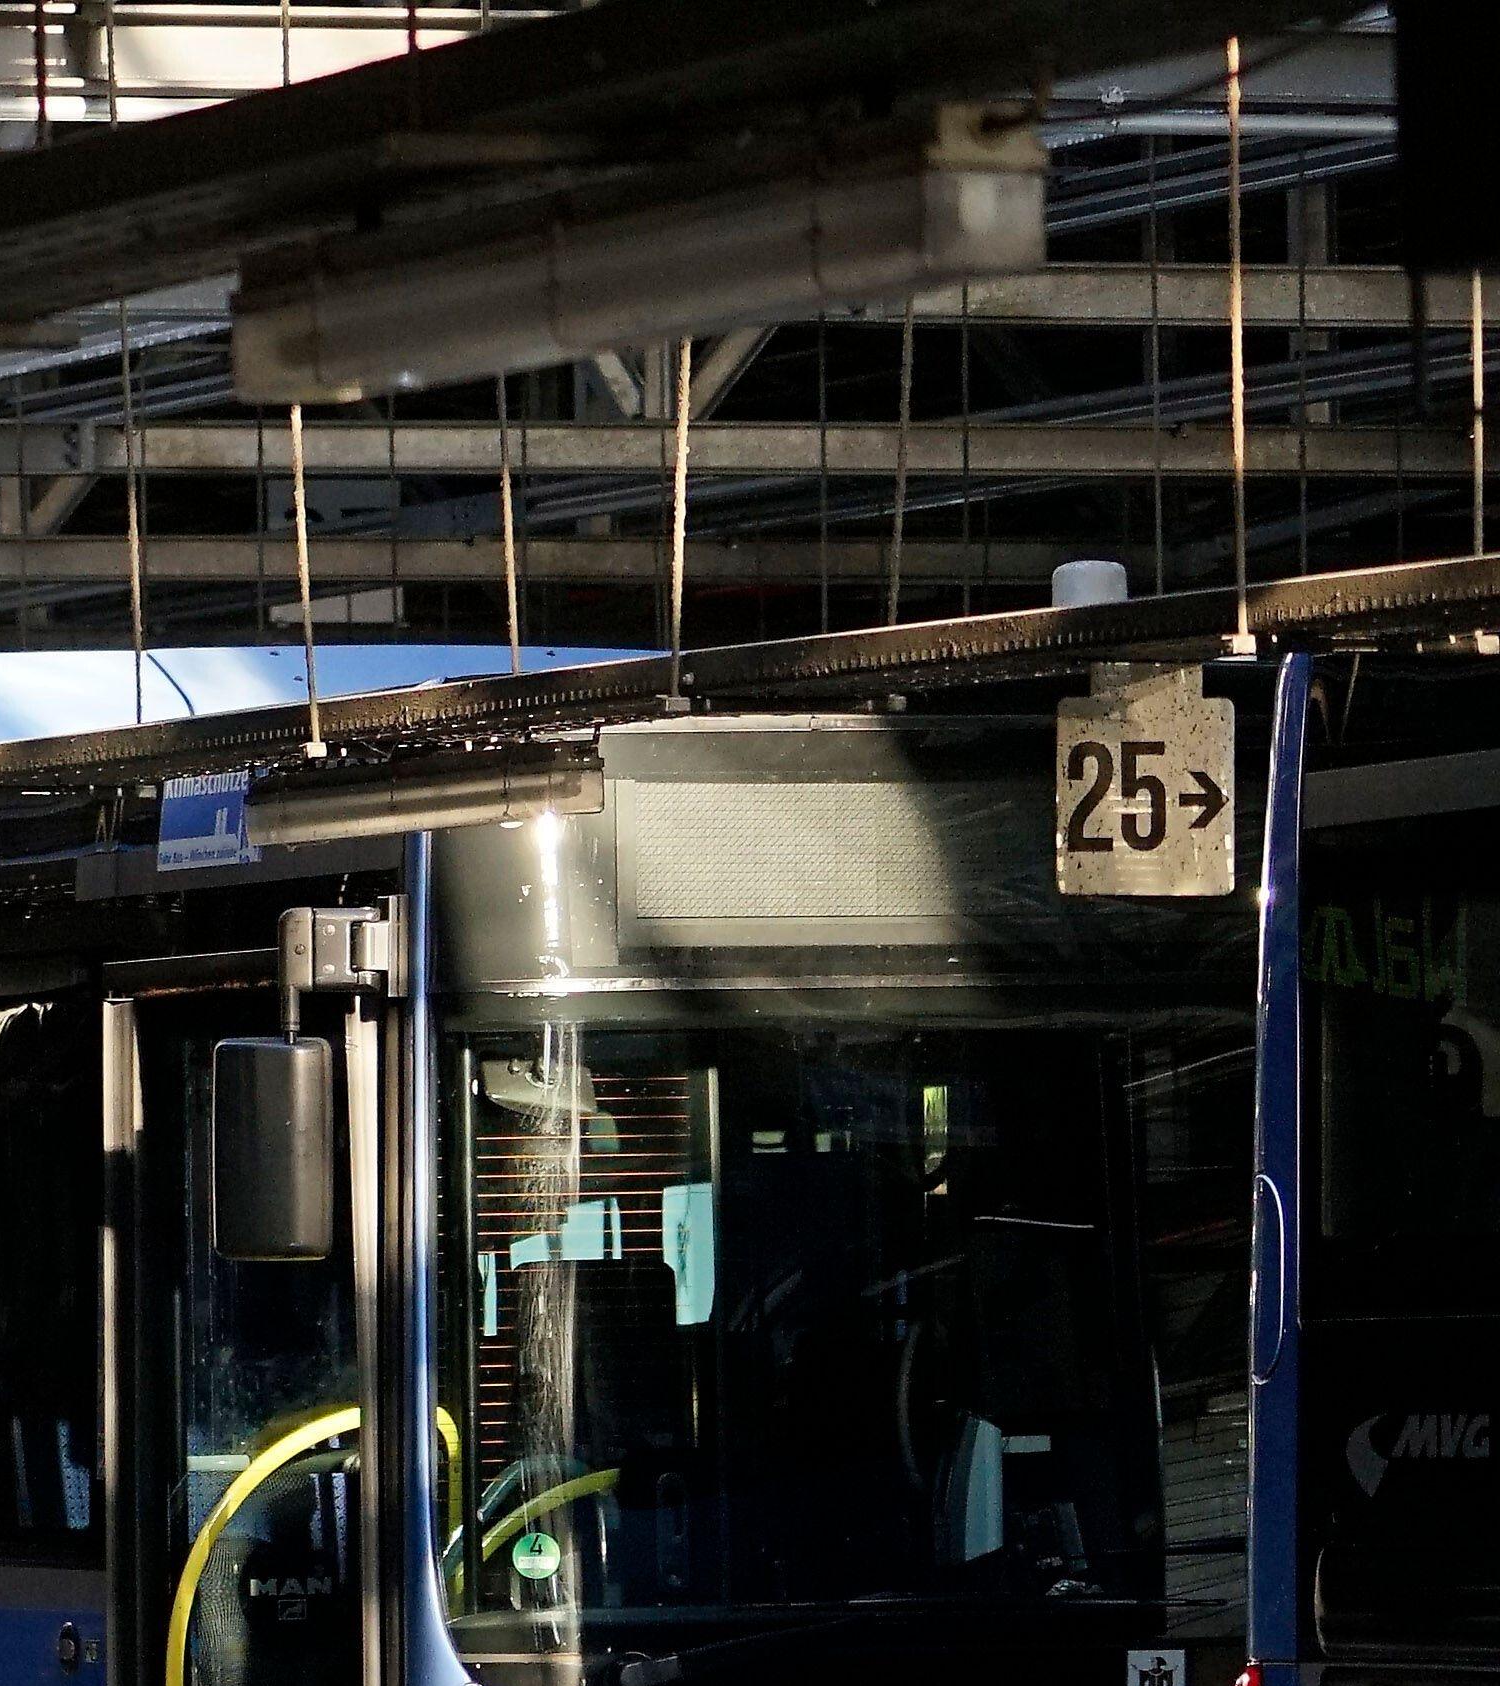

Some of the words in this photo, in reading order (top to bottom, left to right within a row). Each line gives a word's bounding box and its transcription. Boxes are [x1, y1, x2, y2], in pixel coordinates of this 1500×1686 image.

[1067, 741, 1167, 851] 25
[1390, 1413, 1492, 1458] MVG
[530, 1535, 543, 1555] 4
[250, 1577, 331, 1596] MAN
